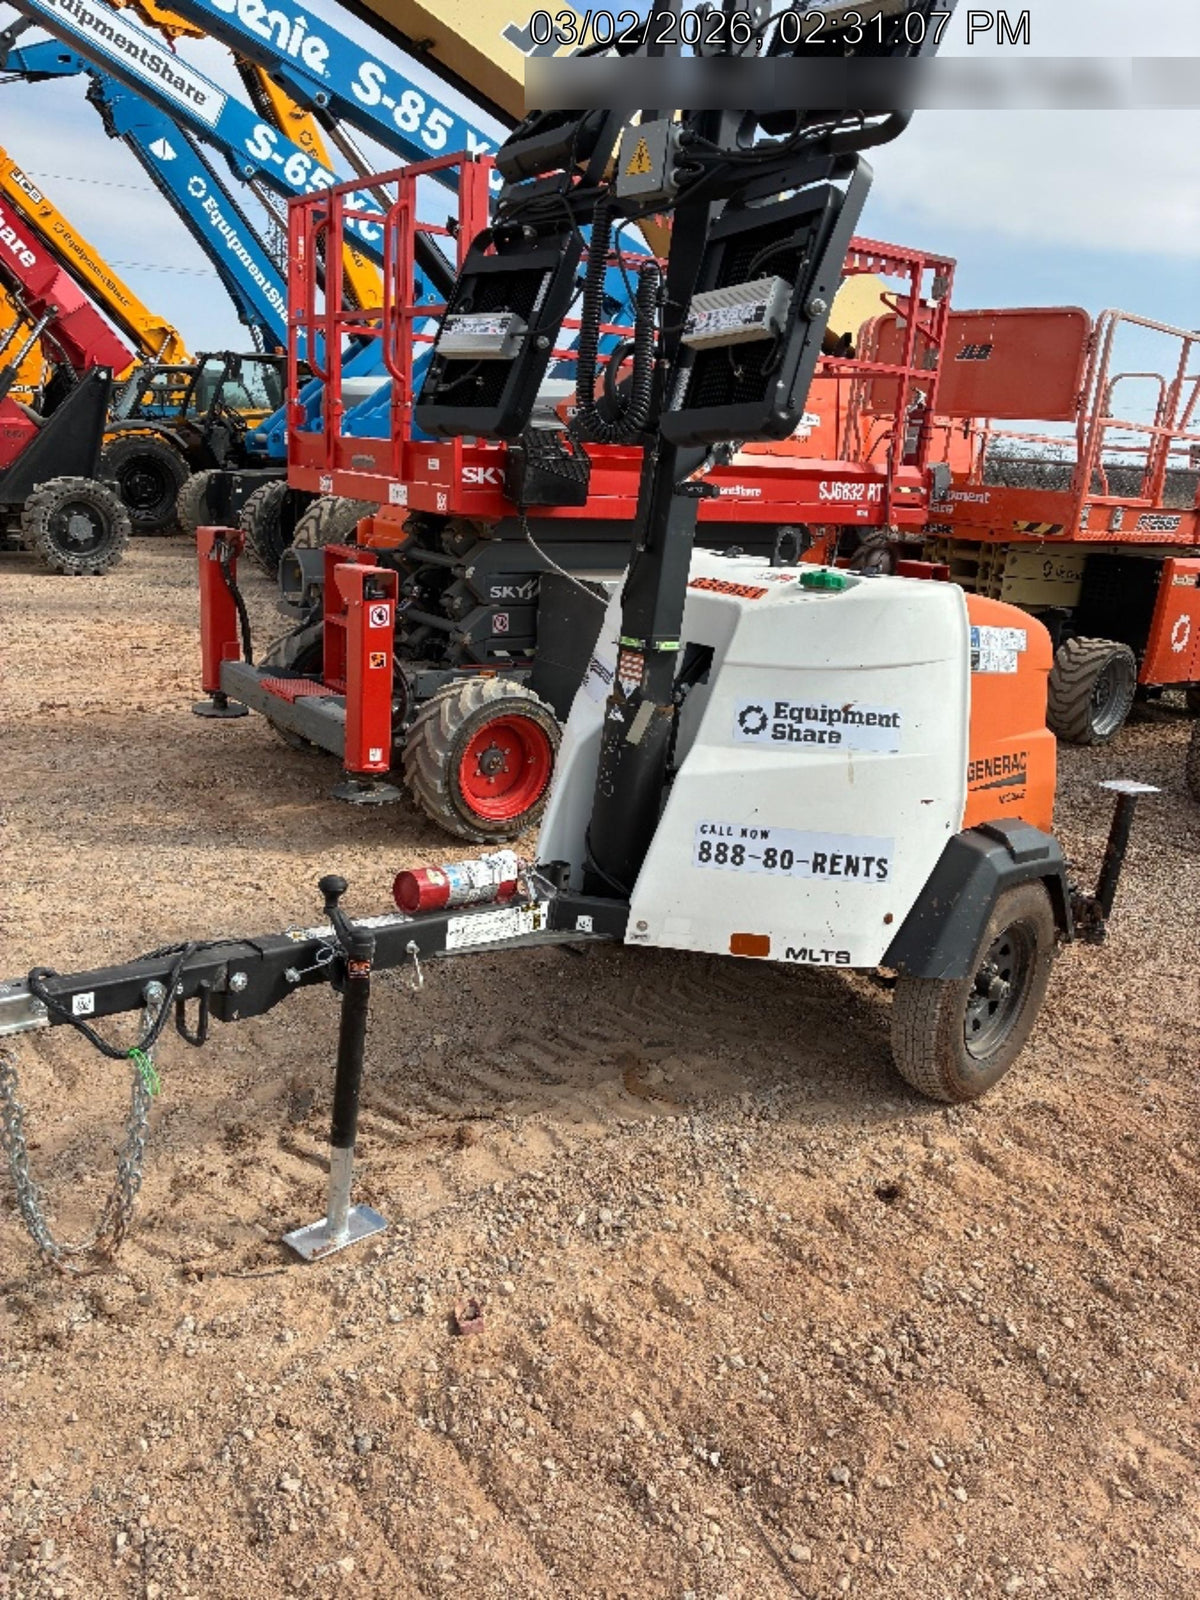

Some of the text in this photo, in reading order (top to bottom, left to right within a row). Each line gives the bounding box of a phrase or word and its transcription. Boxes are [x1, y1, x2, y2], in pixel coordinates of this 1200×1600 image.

[46, 0, 206, 106] uipmentShare
[351, 62, 454, 150] S-85
[244, 124, 335, 197] S-65
[719, 485, 762, 498] entShare
[818, 482, 864, 500] SJ6832
[773, 702, 901, 728] Equipment
[771, 723, 842, 744] Share
[966, 752, 1027, 783] GENERAC
[700, 824, 771, 840] CALL NOW
[698, 840, 889, 878] 888-80-RENTS
